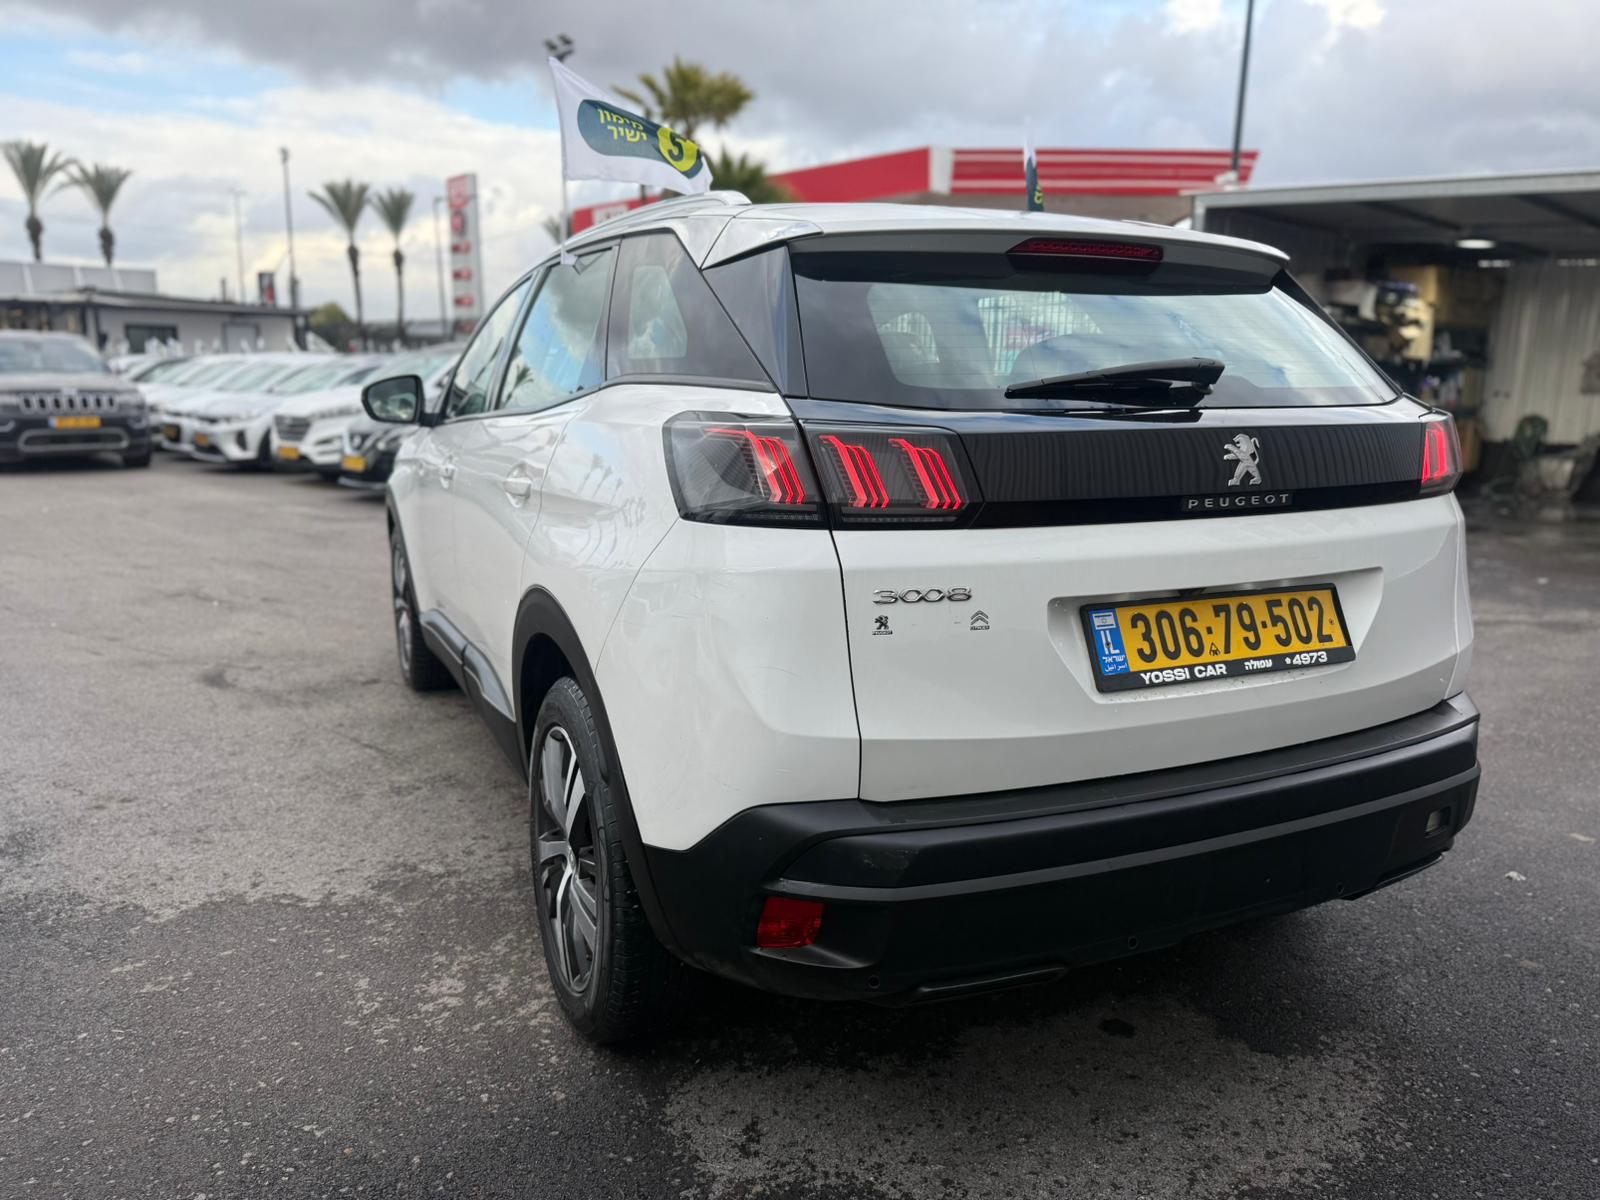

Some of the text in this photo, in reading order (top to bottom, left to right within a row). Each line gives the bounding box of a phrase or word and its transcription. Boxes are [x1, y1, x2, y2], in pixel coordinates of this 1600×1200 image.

[598, 108, 644, 131] מימון
[607, 125, 649, 143] ישיר
[1187, 493, 1290, 509] PEUGEOT
[872, 587, 972, 604] 3008
[1100, 630, 1120, 655] IL
[1102, 654, 1126, 664] ישראל
[1243, 658, 1273, 671] עפולה
[1140, 663, 1228, 685] YOSSI CAR
